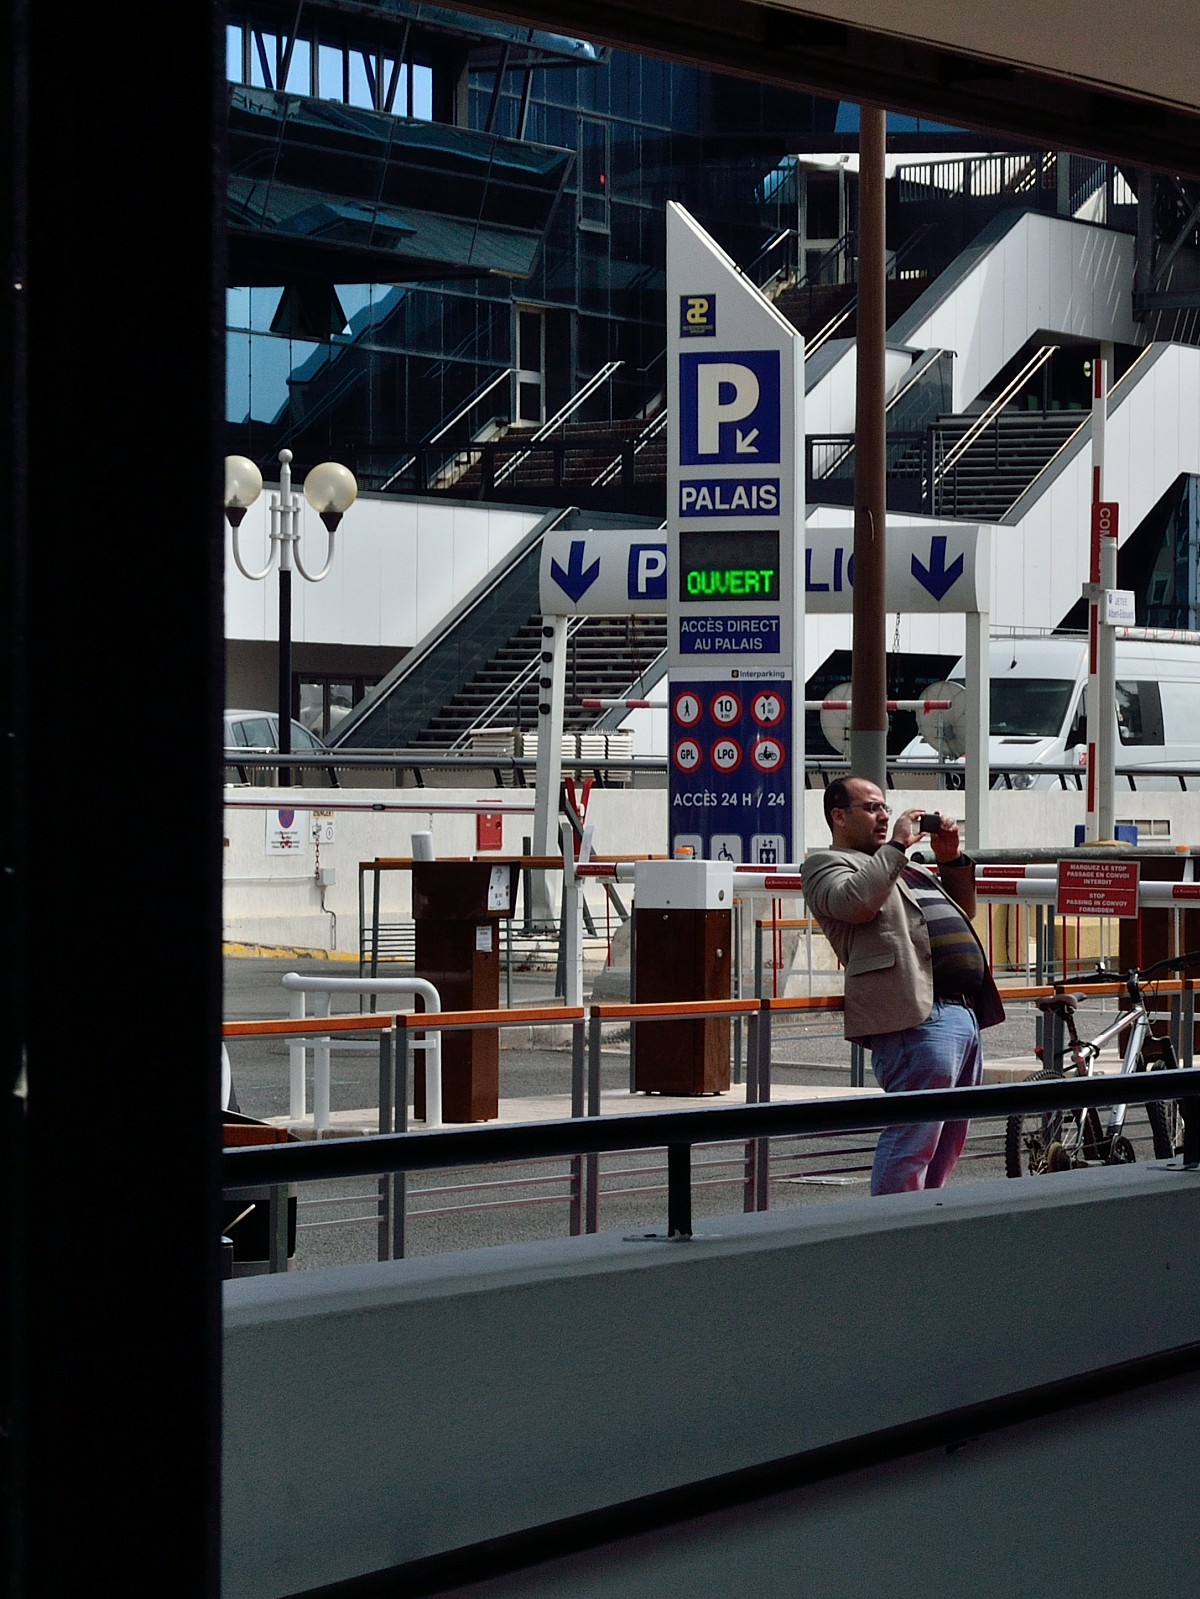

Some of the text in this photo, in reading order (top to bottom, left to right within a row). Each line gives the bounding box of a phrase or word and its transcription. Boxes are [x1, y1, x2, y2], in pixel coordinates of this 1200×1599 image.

[697, 362, 760, 455] P
[681, 484, 778, 511] PALAIS
[637, 549, 667, 593] P
[687, 569, 774, 594] OUVERT
[681, 617, 779, 633] ACCÈS DIRECT
[694, 637, 763, 650] AU PALAIS
[740, 669, 785, 679] Interparking
[717, 699, 733, 712] 10
[760, 702, 766, 714] 1
[680, 749, 695, 760] GPL
[717, 749, 735, 760] LPG
[673, 789, 718, 806] ACCÈS
[721, 792, 738, 806] 24
[742, 792, 752, 806] H
[767, 792, 786, 806] 24
